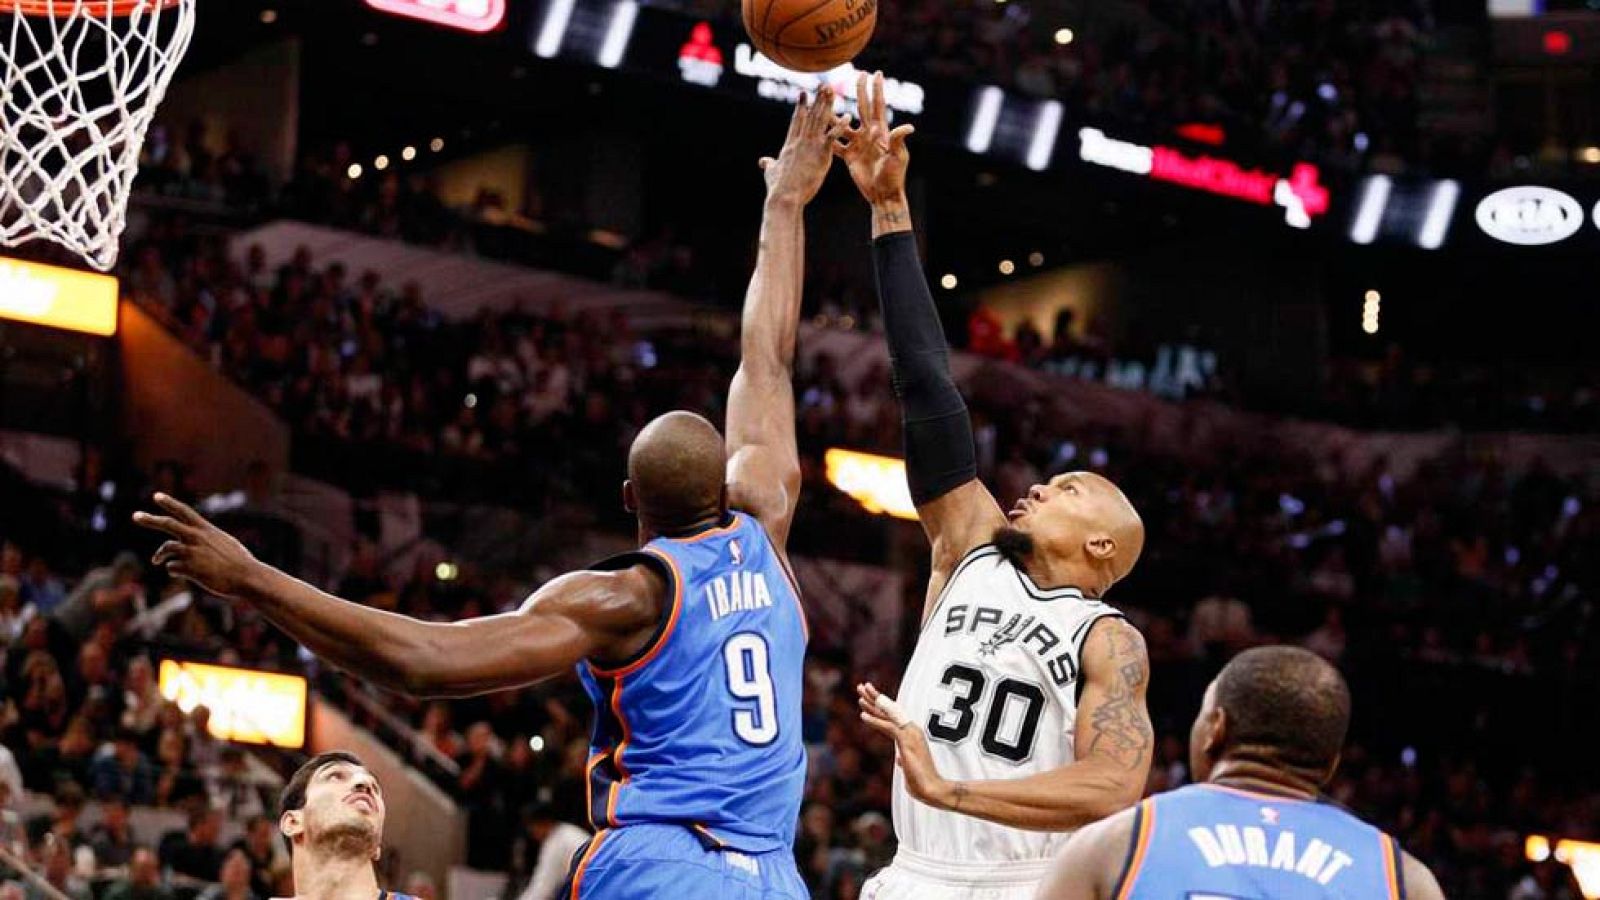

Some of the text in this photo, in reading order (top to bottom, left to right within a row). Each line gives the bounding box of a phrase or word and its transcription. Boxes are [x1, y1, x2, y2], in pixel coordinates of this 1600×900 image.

[815, 0, 876, 44] SPALDI
[706, 570, 773, 621] IBAKA
[944, 604, 1077, 689] SPURS
[722, 631, 779, 747] 9
[928, 662, 1047, 765] 30
[1188, 824, 1353, 885] DURANT
